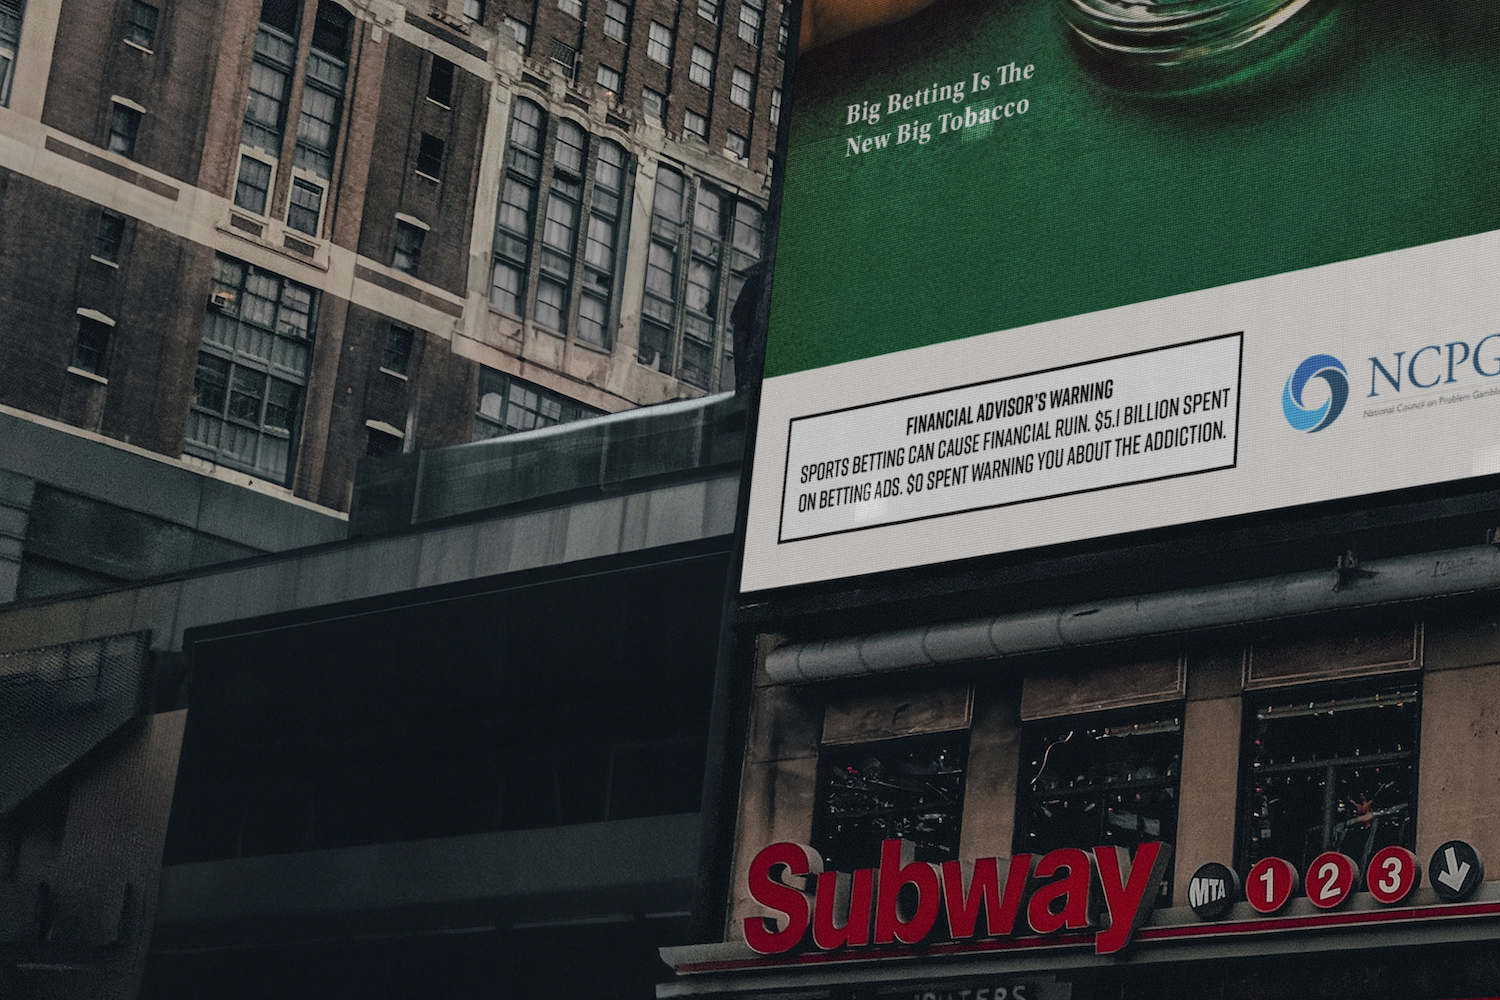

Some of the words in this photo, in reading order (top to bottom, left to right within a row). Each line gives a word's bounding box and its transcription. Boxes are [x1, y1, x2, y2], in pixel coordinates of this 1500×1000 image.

[846, 103, 881, 125] Big
[886, 80, 966, 115] Betting
[971, 72, 991, 93] Is
[997, 61, 1035, 86] The
[845, 132, 892, 158] New
[896, 120, 933, 145] Big
[938, 98, 1030, 136] Tobacco
[800, 457, 849, 484] SPORTS
[852, 446, 905, 475] BETTING
[907, 441, 936, 465] CAN
[937, 431, 980, 460] CAUSE
[982, 418, 1052, 451] FINANCIAL
[1054, 411, 1091, 439] RUIN.
[1094, 407, 1119, 432] $5.1
[1123, 397, 1180, 427] BILLION
[1183, 387, 1231, 416] SPENT
[906, 402, 974, 436] FINANCIAL
[976, 391, 1047, 424] ADVISOR'S
[1049, 379, 1114, 411] WARNING
[1363, 404, 1394, 418] National
[1396, 399, 1426, 414] Council
[1427, 398, 1438, 408] on
[1438, 392, 1471, 405] Problem
[798, 493, 817, 513] ON
[818, 480, 871, 509] BETTING
[873, 475, 903, 500] ADS.
[906, 471, 924, 495] $0
[927, 464, 969, 491] SPENT
[971, 452, 1034, 482] WARNING
[1037, 448, 1065, 471] YOU
[1066, 439, 1112, 466] ABOUT
[1114, 433, 1141, 456] THE
[1143, 419, 1227, 452] ADDICTION.
[743, 838, 1166, 955] Subway
[1190, 877, 1226, 909] MTA
[1259, 868, 1274, 903] 1
[1317, 863, 1342, 901] 2
[1378, 856, 1403, 894] 3
